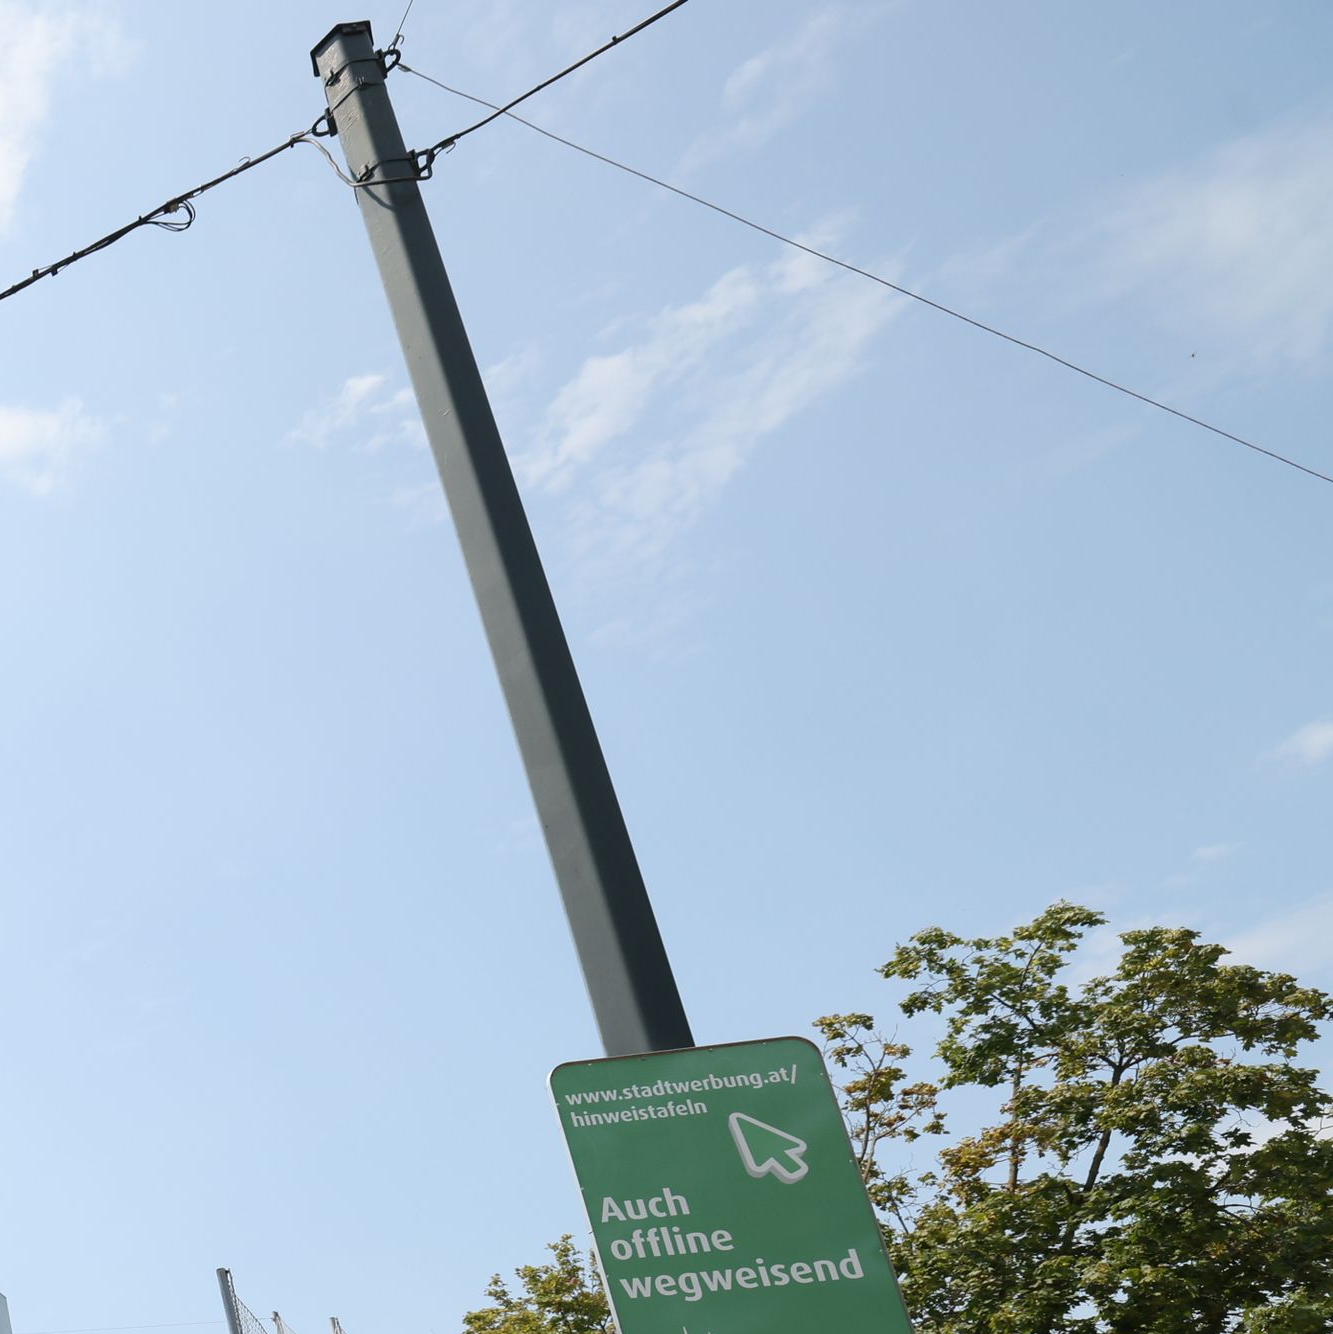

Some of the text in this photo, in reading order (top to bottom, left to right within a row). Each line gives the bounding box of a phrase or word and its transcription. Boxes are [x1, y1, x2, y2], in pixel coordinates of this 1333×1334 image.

[565, 1064, 797, 1106] www.stadtwerbung.at/
[571, 1099, 708, 1127] hinweistafeln
[601, 1187, 690, 1222] Auch
[610, 1226, 734, 1261] offline
[620, 1248, 864, 1301] wegweisend
